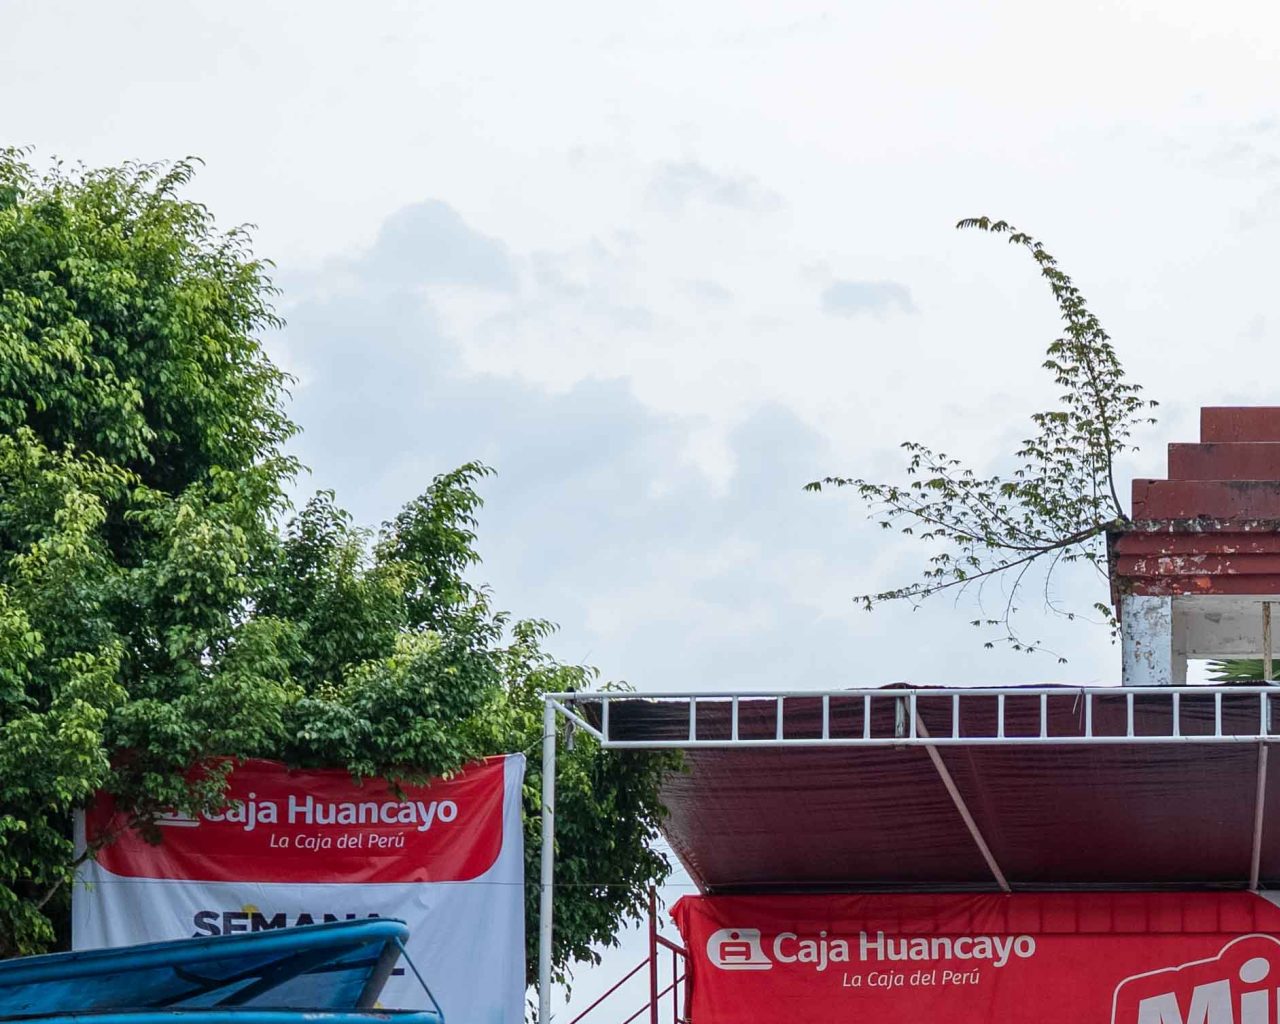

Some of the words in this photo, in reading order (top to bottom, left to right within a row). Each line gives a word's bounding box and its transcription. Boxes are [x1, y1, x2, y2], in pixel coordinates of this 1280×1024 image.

[288, 795, 458, 831] Huancayo
[270, 834, 289, 848] La
[294, 834, 332, 851] Caja
[337, 833, 363, 848] del
[368, 832, 405, 848] Perú
[773, 931, 849, 971] Caja
[860, 931, 1036, 967] Huancayo
[843, 972, 861, 987] La
[867, 971, 905, 990] Caja
[910, 970, 936, 986] del
[942, 968, 979, 985] Perú
